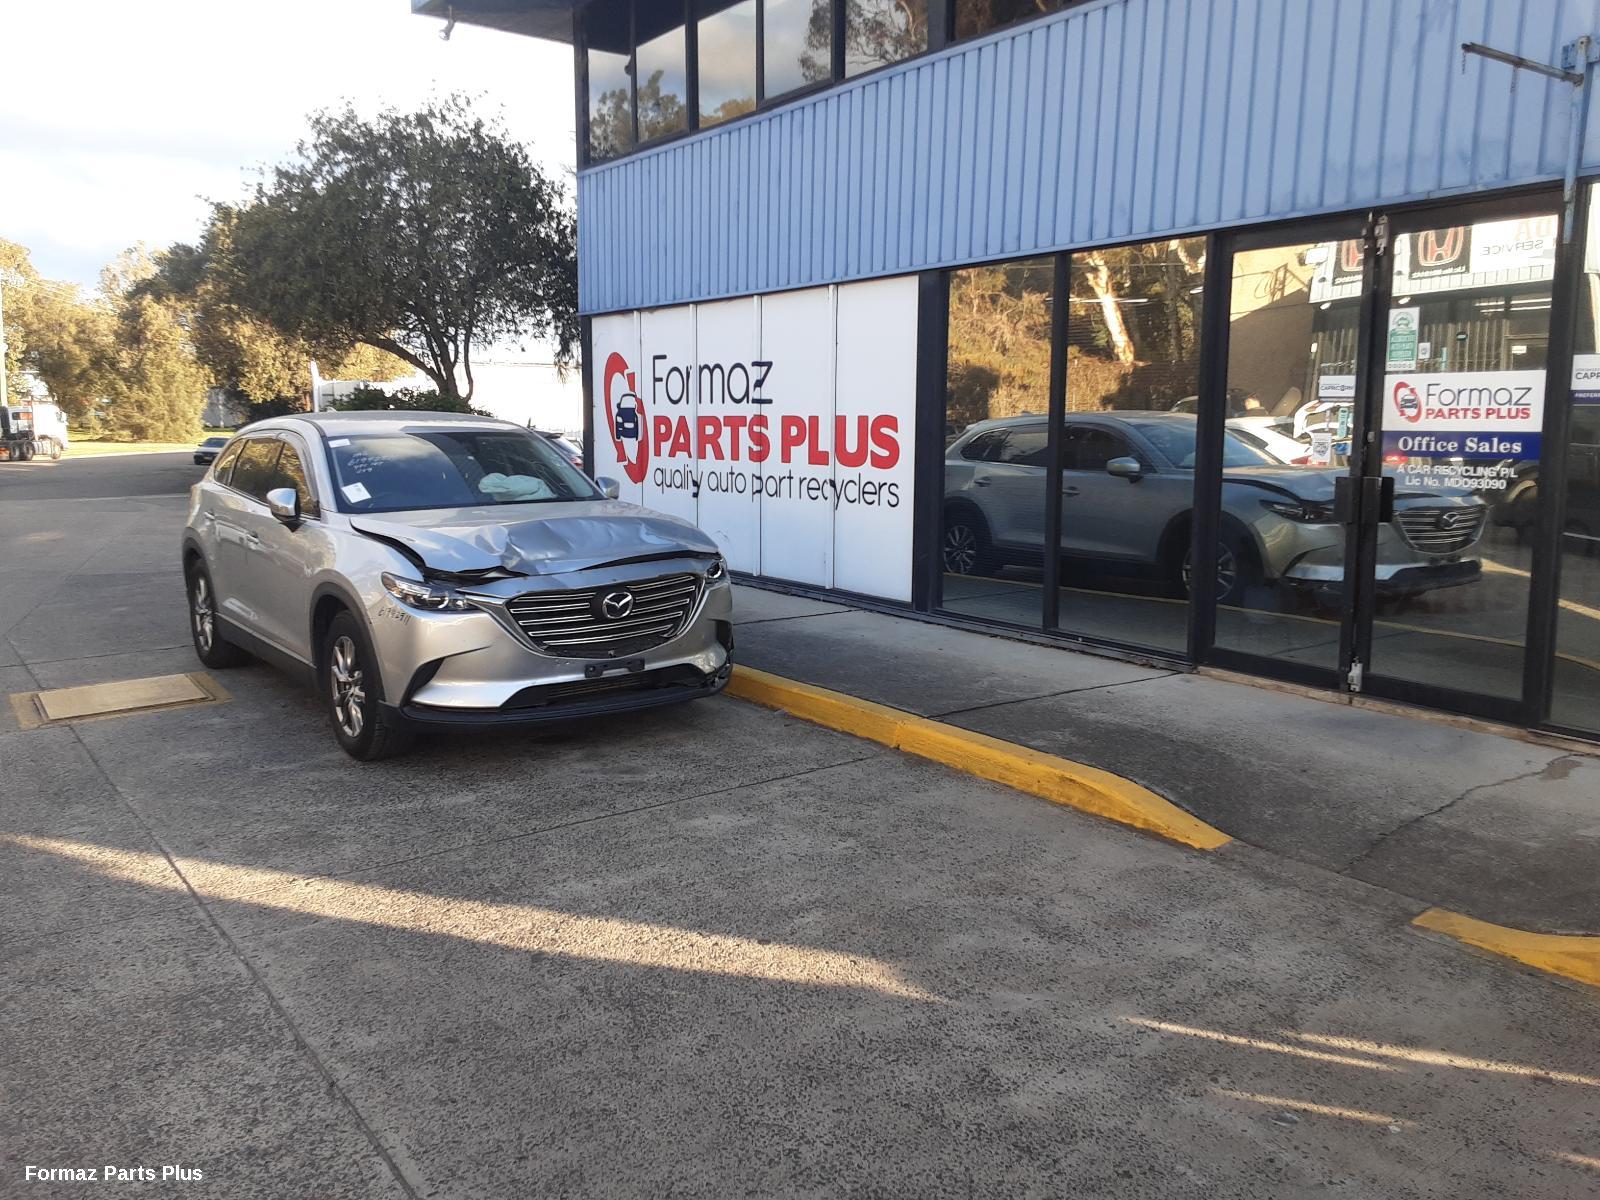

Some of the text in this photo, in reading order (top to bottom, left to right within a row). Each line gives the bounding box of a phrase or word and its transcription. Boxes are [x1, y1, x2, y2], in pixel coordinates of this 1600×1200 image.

[652, 354, 773, 405] Formaz
[1426, 383, 1532, 406] Formaz
[1426, 408, 1530, 420] PARTS PLUS
[653, 414, 900, 470] PARTS PLUS
[1398, 436, 1522, 454] Office Sales
[1407, 464, 1431, 475] CAR
[1434, 465, 1497, 477] RECYCLING
[1500, 467, 1518, 478] P/L
[653, 464, 900, 510] qualiy auto part recyclers
[1405, 476, 1420, 486] Lic
[1424, 477, 1441, 487] No.
